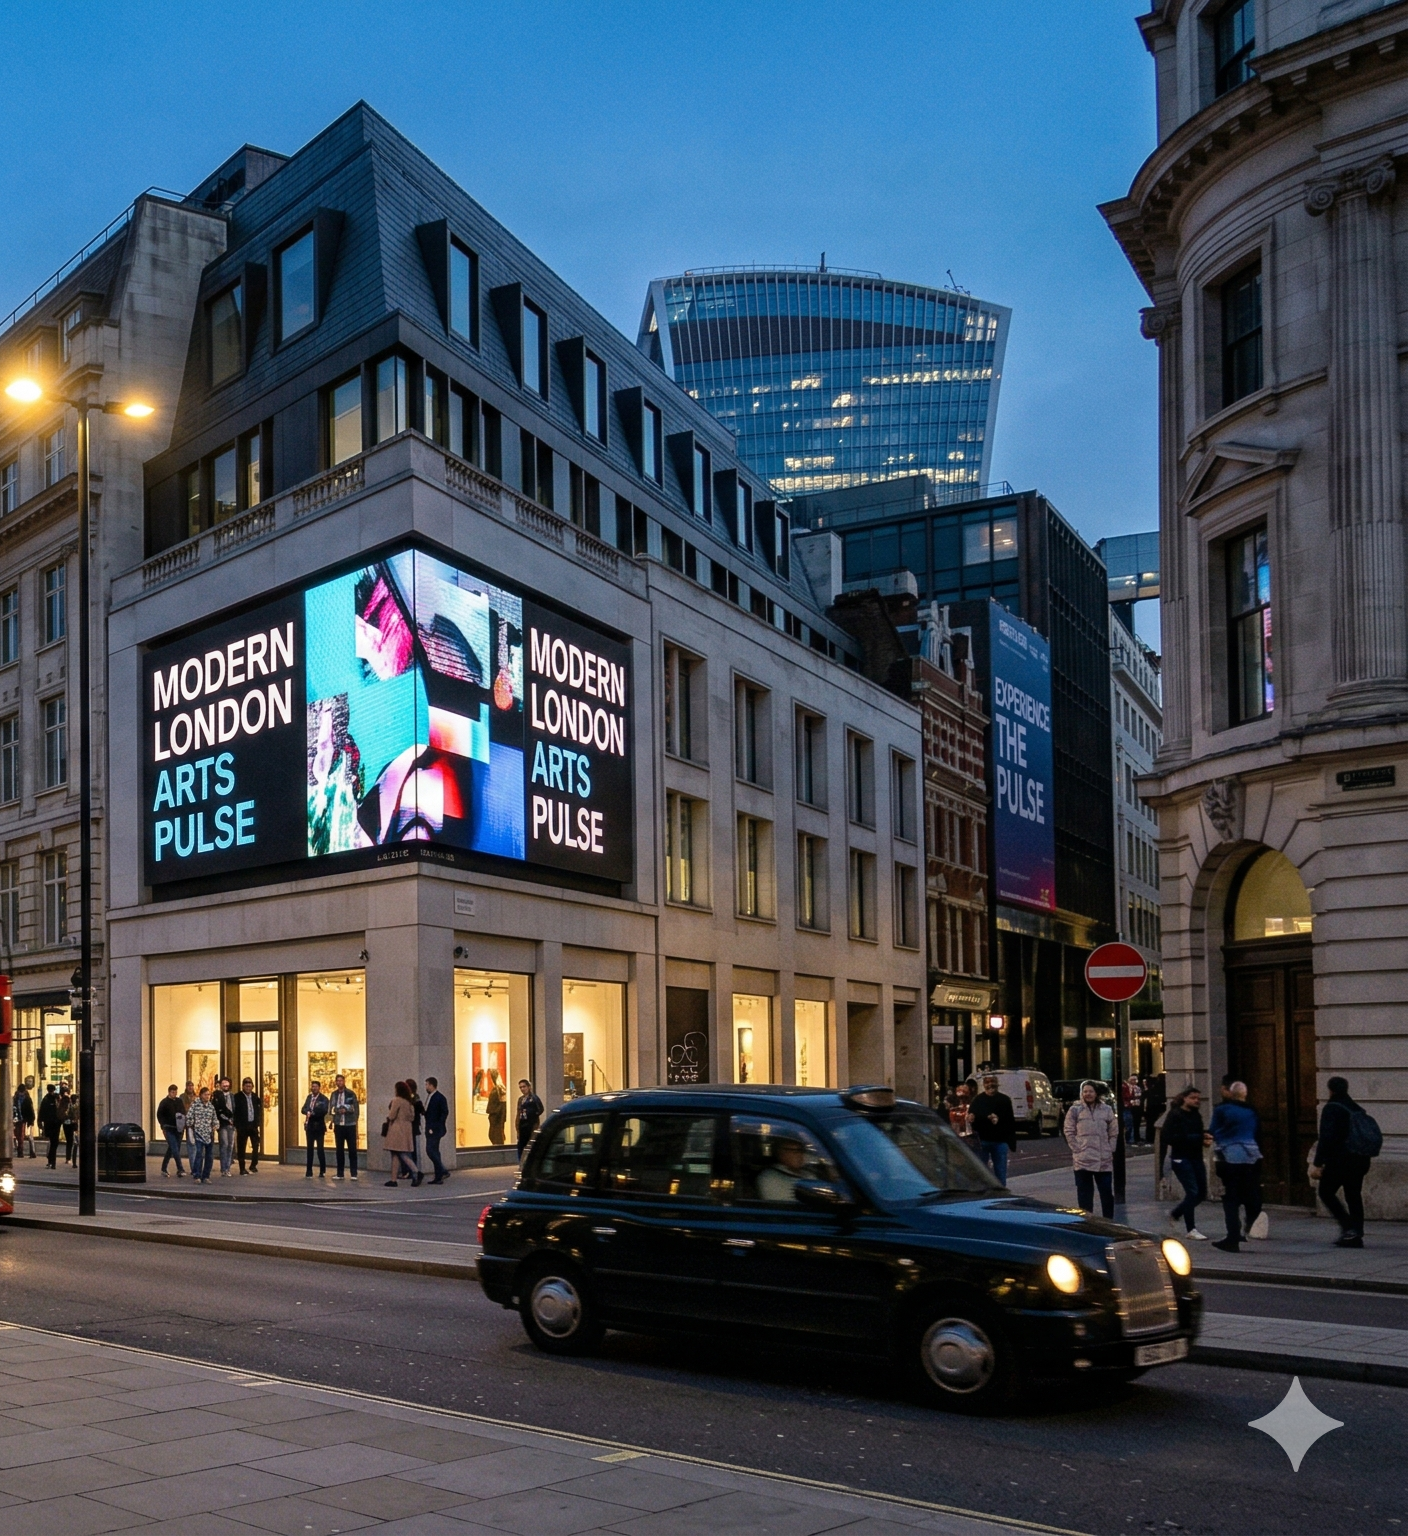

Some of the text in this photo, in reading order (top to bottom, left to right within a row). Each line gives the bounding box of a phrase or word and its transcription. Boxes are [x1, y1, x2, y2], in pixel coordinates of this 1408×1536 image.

[153, 622, 294, 712] MODERN
[530, 627, 625, 707] MODERN
[154, 678, 292, 762] LONDON
[531, 683, 625, 757] LONDON
[995, 676, 1051, 733] EXPERIENCE
[531, 740, 591, 798] ARTS
[995, 712, 1028, 769] THE
[153, 752, 235, 812] ARTS
[996, 764, 1045, 825] PULSE
[155, 800, 255, 862] PULSE
[532, 795, 604, 854] PULSE
